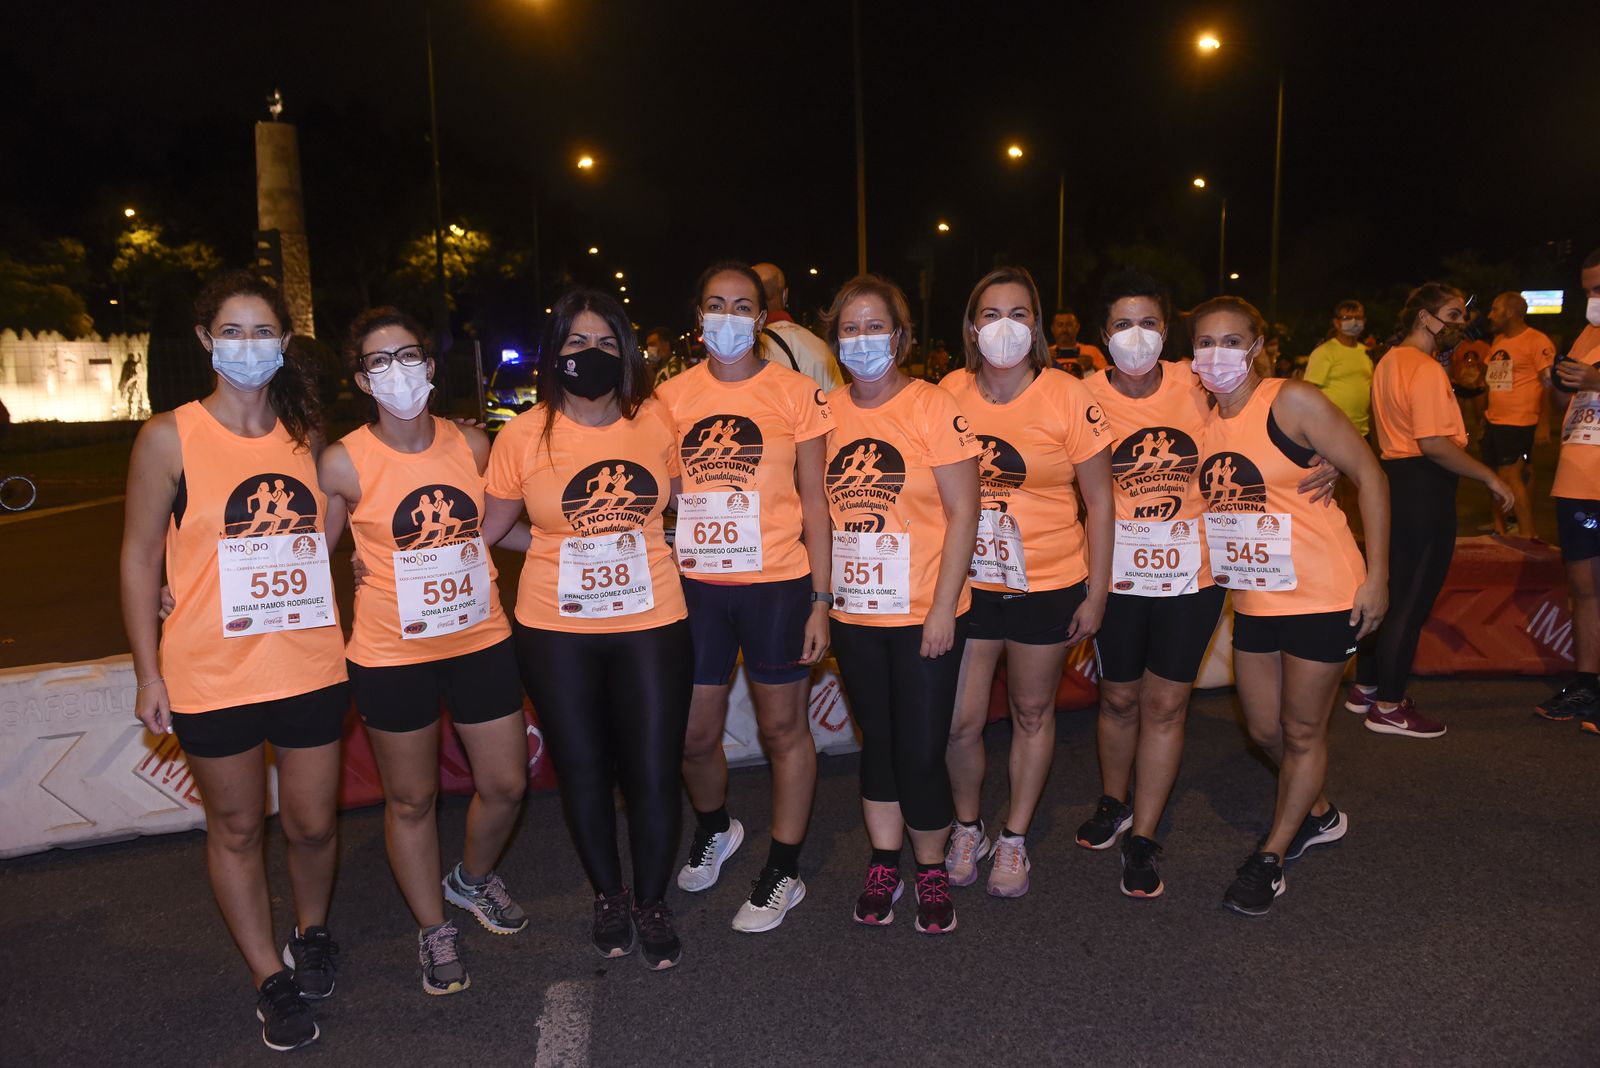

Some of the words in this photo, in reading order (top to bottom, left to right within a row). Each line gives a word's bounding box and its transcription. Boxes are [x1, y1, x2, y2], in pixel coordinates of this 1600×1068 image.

[687, 467, 699, 477] LA
[700, 462, 755, 476] NOCTURNA
[696, 475, 705, 484] del
[705, 472, 748, 483] Guadalquivir
[1120, 481, 1133, 490] LA
[1130, 488, 1140, 497] del
[1140, 483, 1184, 494] Guadalquivir
[831, 495, 840, 504] LA
[841, 489, 896, 504] NOCTURNA
[846, 500, 888, 511] Guadalquivir
[572, 520, 585, 531] LA
[588, 512, 645, 526] NOCTURNA
[693, 521, 738, 544] 626
[726, 546, 757, 554] GONZÁLEZ
[975, 538, 1009, 561] 615
[1226, 542, 1270, 564] 545
[1134, 548, 1180, 569] 650
[581, 564, 630, 591] 538
[843, 561, 884, 585] 551
[250, 568, 307, 599] 559
[423, 573, 474, 606] 594
[233, 604, 259, 612] MIRIAM
[261, 601, 285, 610] RAMOS
[443, 605, 458, 613] PAEZ
[459, 599, 476, 609] PONCE
